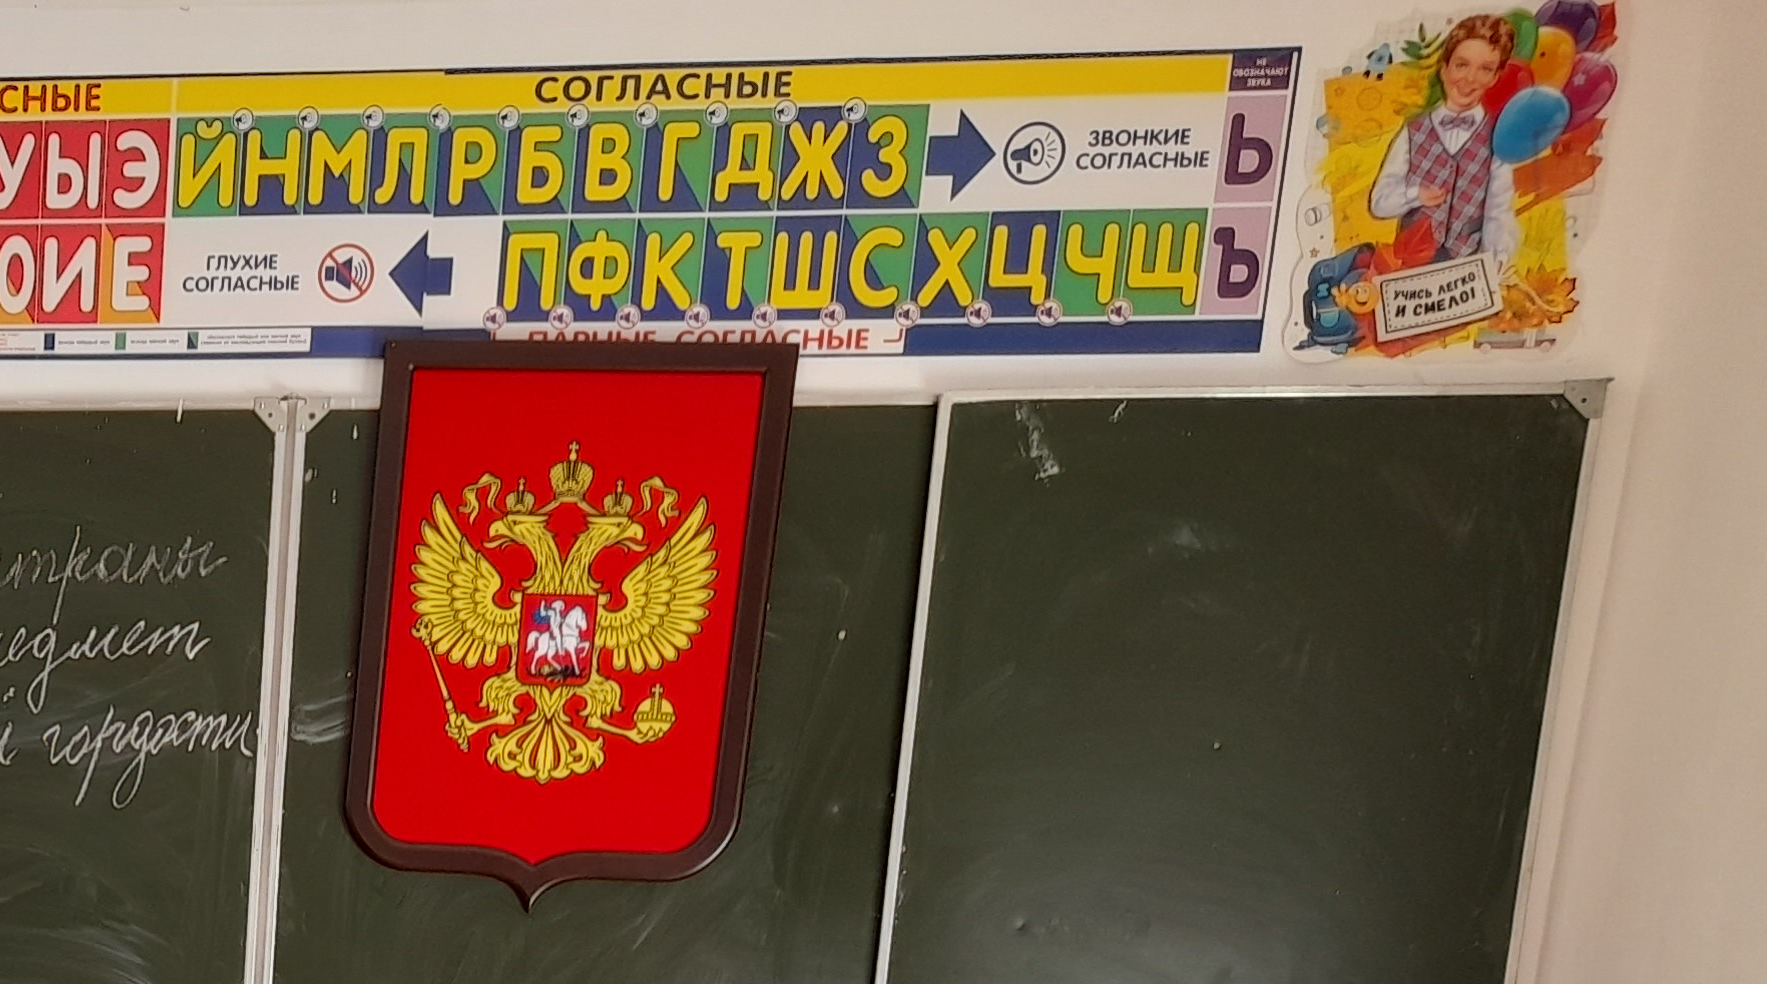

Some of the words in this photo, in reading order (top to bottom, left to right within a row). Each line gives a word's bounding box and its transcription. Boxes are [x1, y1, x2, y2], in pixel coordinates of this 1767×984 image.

[534, 71, 794, 103] СОГЛАСНЫЕ
[1088, 128, 1191, 148] ЗВОНКИЕ
[1223, 112, 1273, 186] Ь
[1076, 149, 1210, 170] СОГЛАСНЫЕ
[205, 254, 279, 274] ГЛУХИЕ
[1213, 226, 1259, 299] Ъ
[182, 275, 300, 294] СОГЛАСНЫЕ
[1394, 288, 1432, 300] УЧИСЬ
[1438, 272, 1476, 296] ЛЕГКО
[1395, 305, 1406, 317] И
[1413, 287, 1475, 316] СМЕЛО!
[42, 704, 254, 808] гордости
